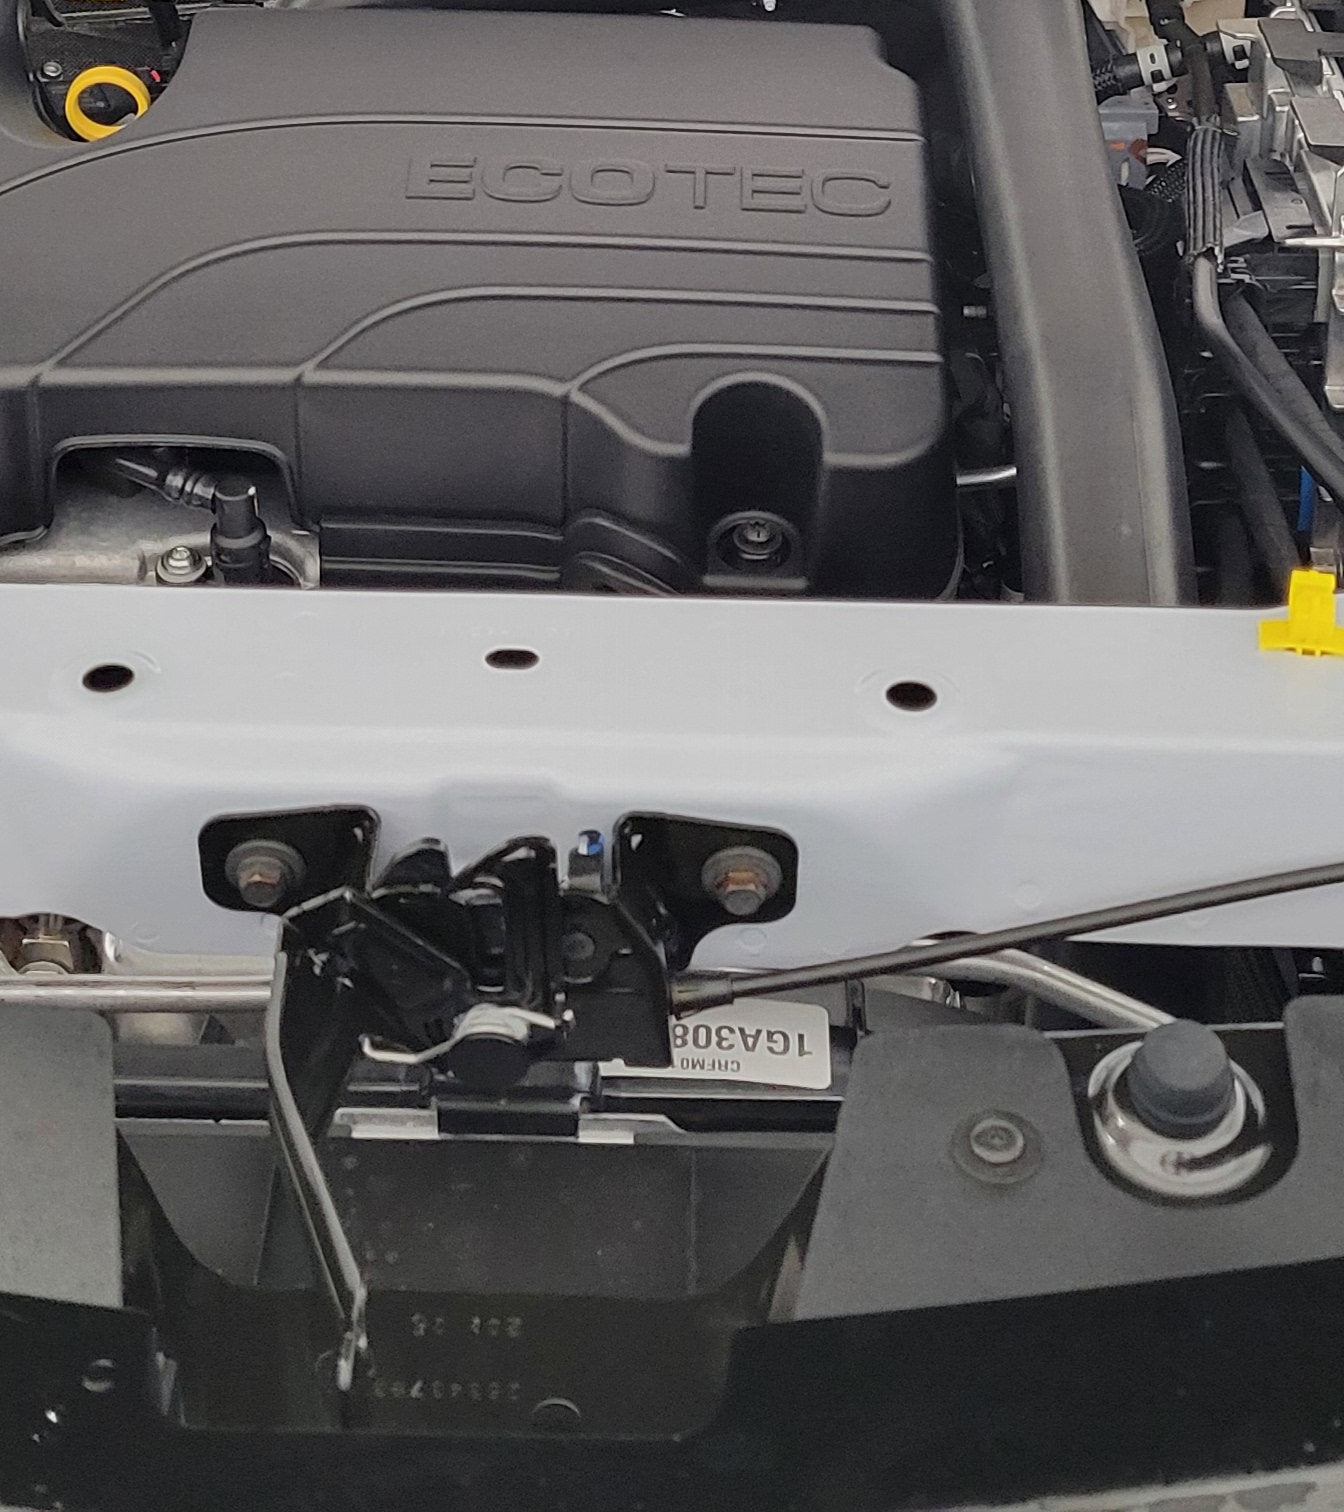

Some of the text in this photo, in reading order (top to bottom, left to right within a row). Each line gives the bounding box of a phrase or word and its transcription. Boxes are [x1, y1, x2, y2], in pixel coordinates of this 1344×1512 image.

[403, 155, 893, 218] ECOTEC
[672, 1023, 813, 1057] 1GA308
[671, 1057, 741, 1073] CRFM0
